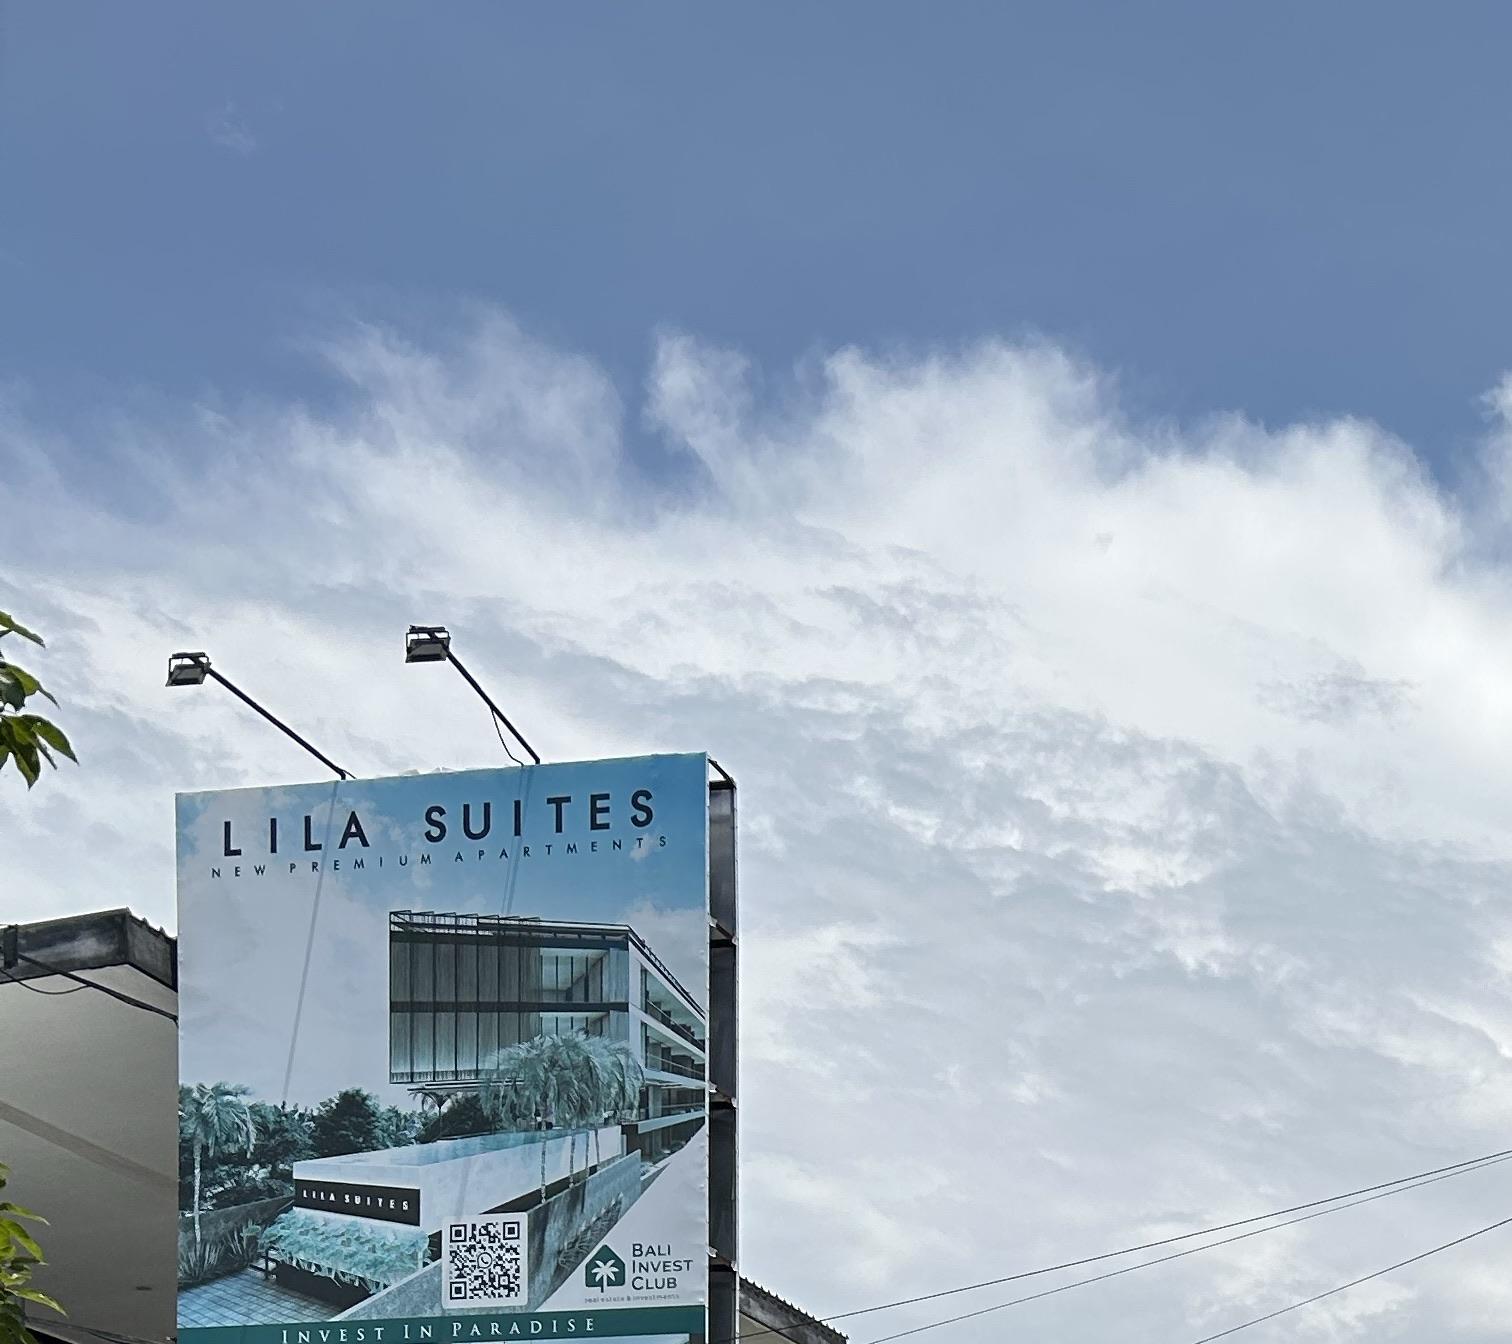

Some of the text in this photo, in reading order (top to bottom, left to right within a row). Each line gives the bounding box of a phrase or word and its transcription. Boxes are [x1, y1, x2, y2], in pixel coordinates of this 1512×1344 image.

[224, 789, 655, 858] LILA SUITES
[211, 835, 668, 879] NEW PREMIUM APARTMENTS
[303, 1189, 409, 1211] LILA SUITES
[631, 1243, 671, 1258] BALI
[631, 1259, 693, 1274] INVEST
[630, 1276, 678, 1291] CLUB
[281, 1317, 596, 1344] INVEST IN PARADISE
